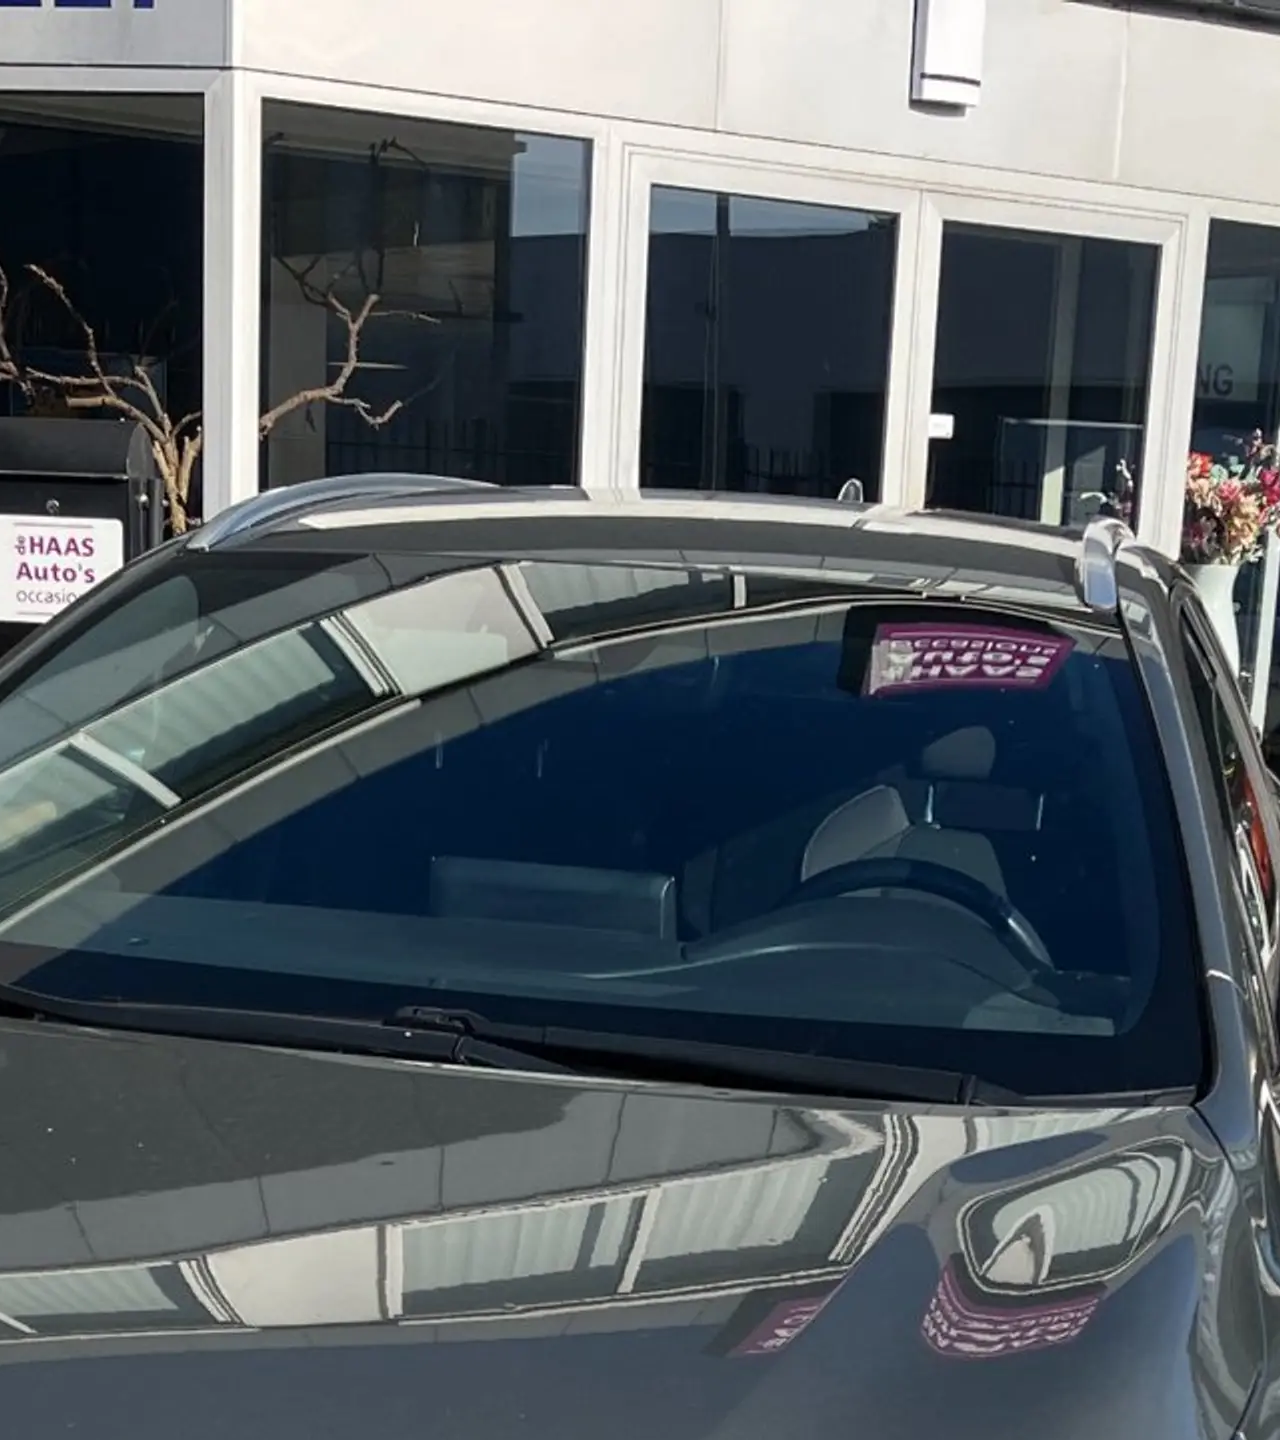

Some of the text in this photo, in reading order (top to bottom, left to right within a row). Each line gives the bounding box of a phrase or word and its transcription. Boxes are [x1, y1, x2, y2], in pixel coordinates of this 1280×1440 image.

[29, 535, 95, 558] HAAS
[16, 561, 96, 583] Auto's
[16, 588, 83, 605] occasio
